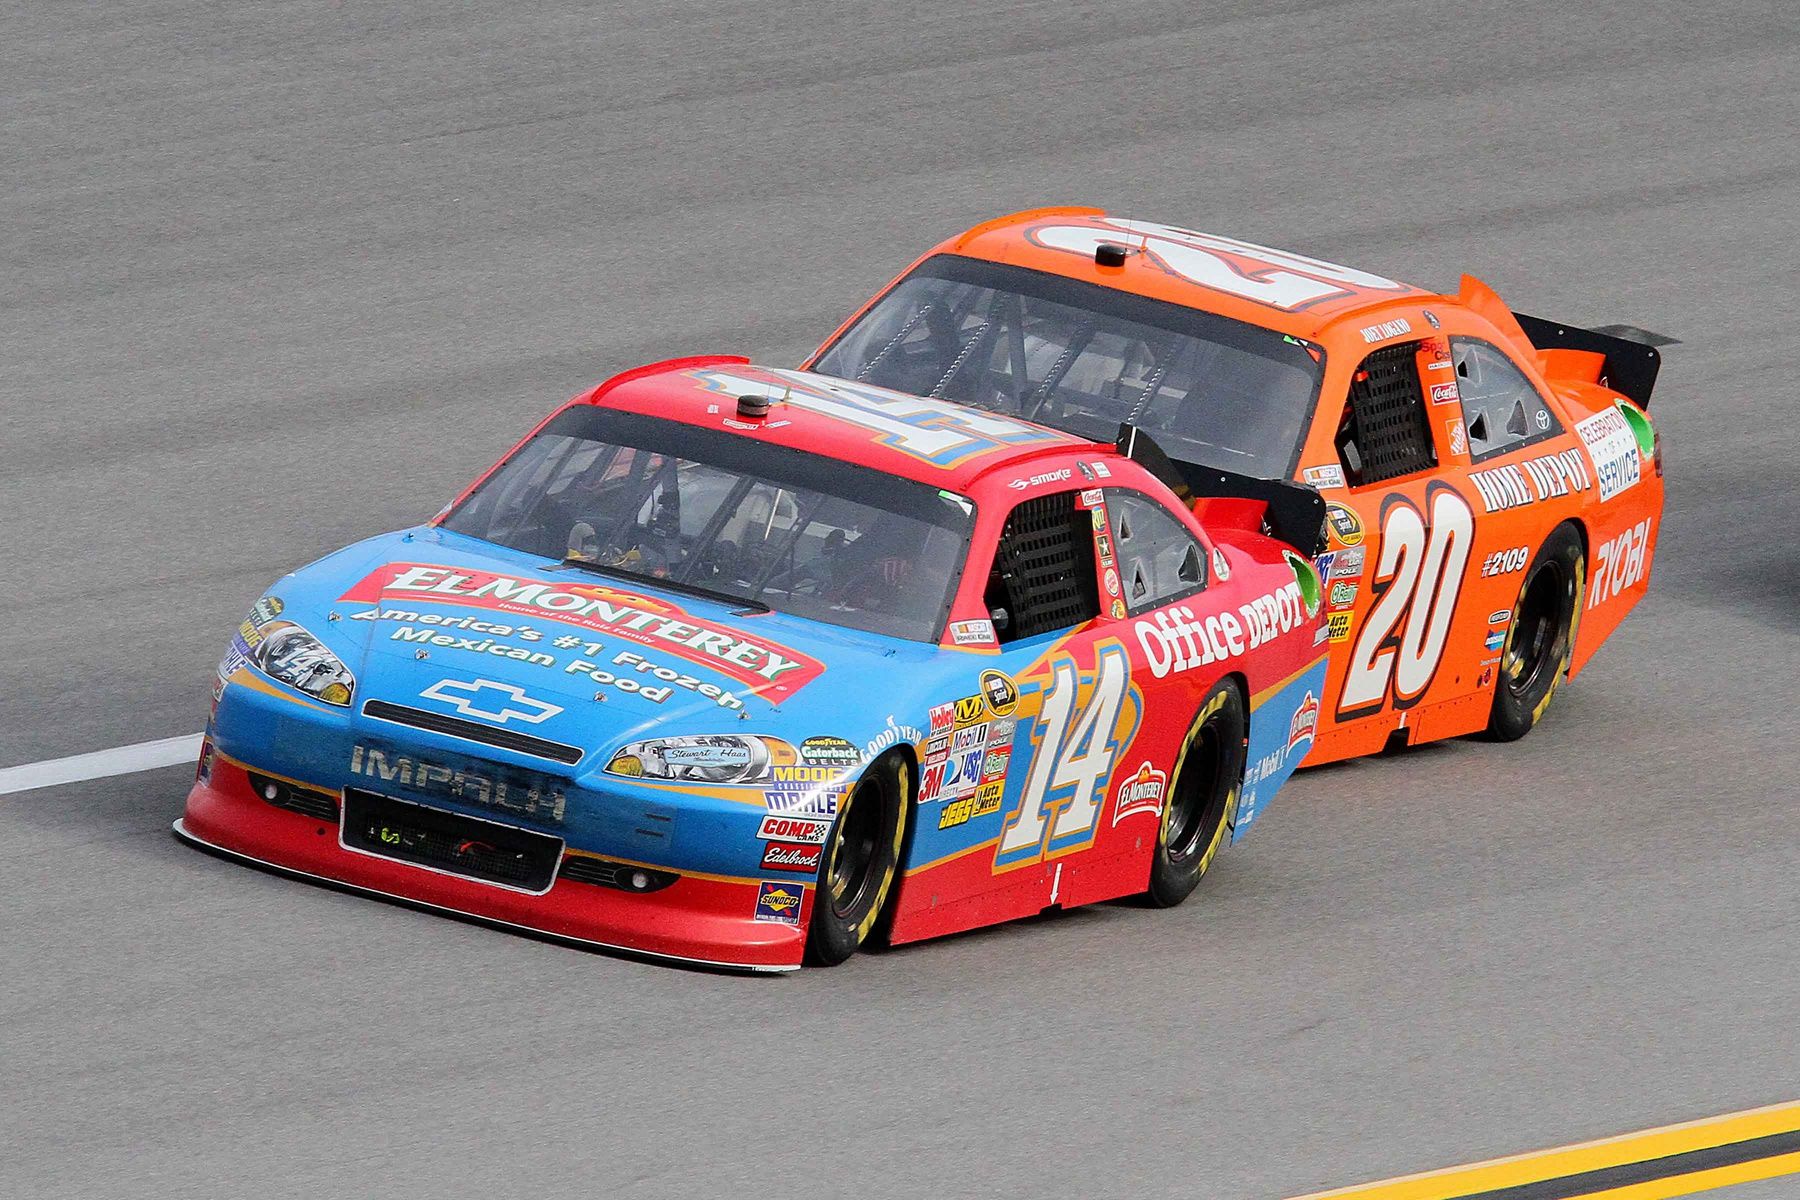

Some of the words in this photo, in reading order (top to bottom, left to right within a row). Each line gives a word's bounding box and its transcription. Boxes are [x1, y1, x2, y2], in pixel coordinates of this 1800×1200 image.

[1580, 411, 1627, 446] CELEBRATION
[1468, 463, 1534, 513] HOME
[1521, 447, 1591, 501] DEPOT
[1598, 449, 1639, 496] SERVICE
[1481, 547, 1529, 577] #2109
[1588, 517, 1651, 610] RYOBI
[498, 602, 537, 614] Home
[539, 610, 557, 618] of
[557, 613, 580, 622] the
[1338, 486, 1474, 712] 20
[1135, 605, 1245, 679] Office
[1239, 582, 1303, 650] DEPOT
[351, 607, 544, 642] America's
[552, 634, 604, 657] #1
[611, 651, 745, 711] Frozen
[390, 626, 557, 668] Mexican
[565, 659, 675, 704] Food
[668, 749, 711, 759] Stewart
[720, 749, 746, 757] Haas
[801, 746, 858, 759] Gatorback
[805, 738, 847, 747] GOODYEAR
[953, 726, 978, 751] Mobil
[997, 648, 1117, 854] 14
[808, 758, 858, 766] BELTS
[963, 750, 981, 782] USG
[918, 764, 945, 801] 3M
[763, 818, 816, 837] COMP
[939, 797, 974, 829] JEGS
[764, 847, 820, 867] Edelbrock
[761, 895, 800, 906] SUNOCO
